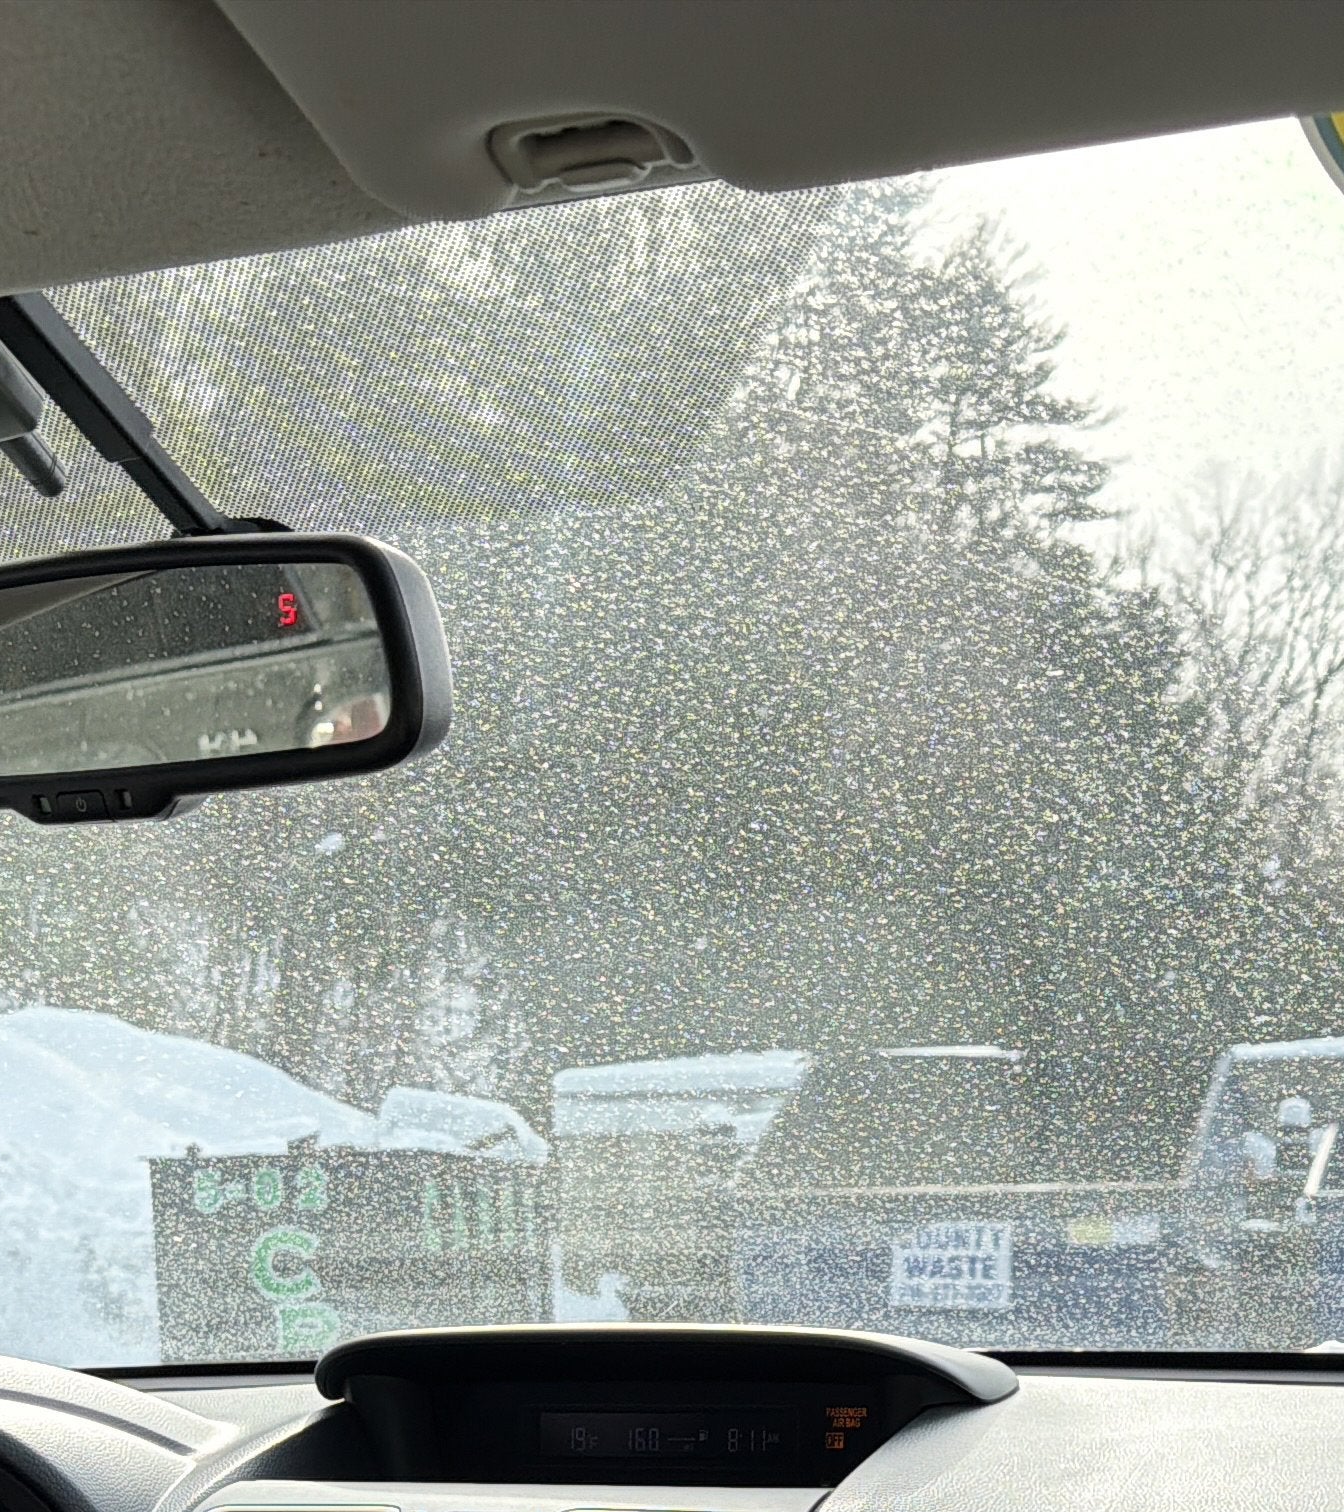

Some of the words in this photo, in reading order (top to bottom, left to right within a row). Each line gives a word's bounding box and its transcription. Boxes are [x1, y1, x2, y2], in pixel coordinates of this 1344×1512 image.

[904, 1254, 996, 1280] WASTE
[825, 1407, 868, 1419] PASSENGER
[825, 1432, 844, 1448] OFF
